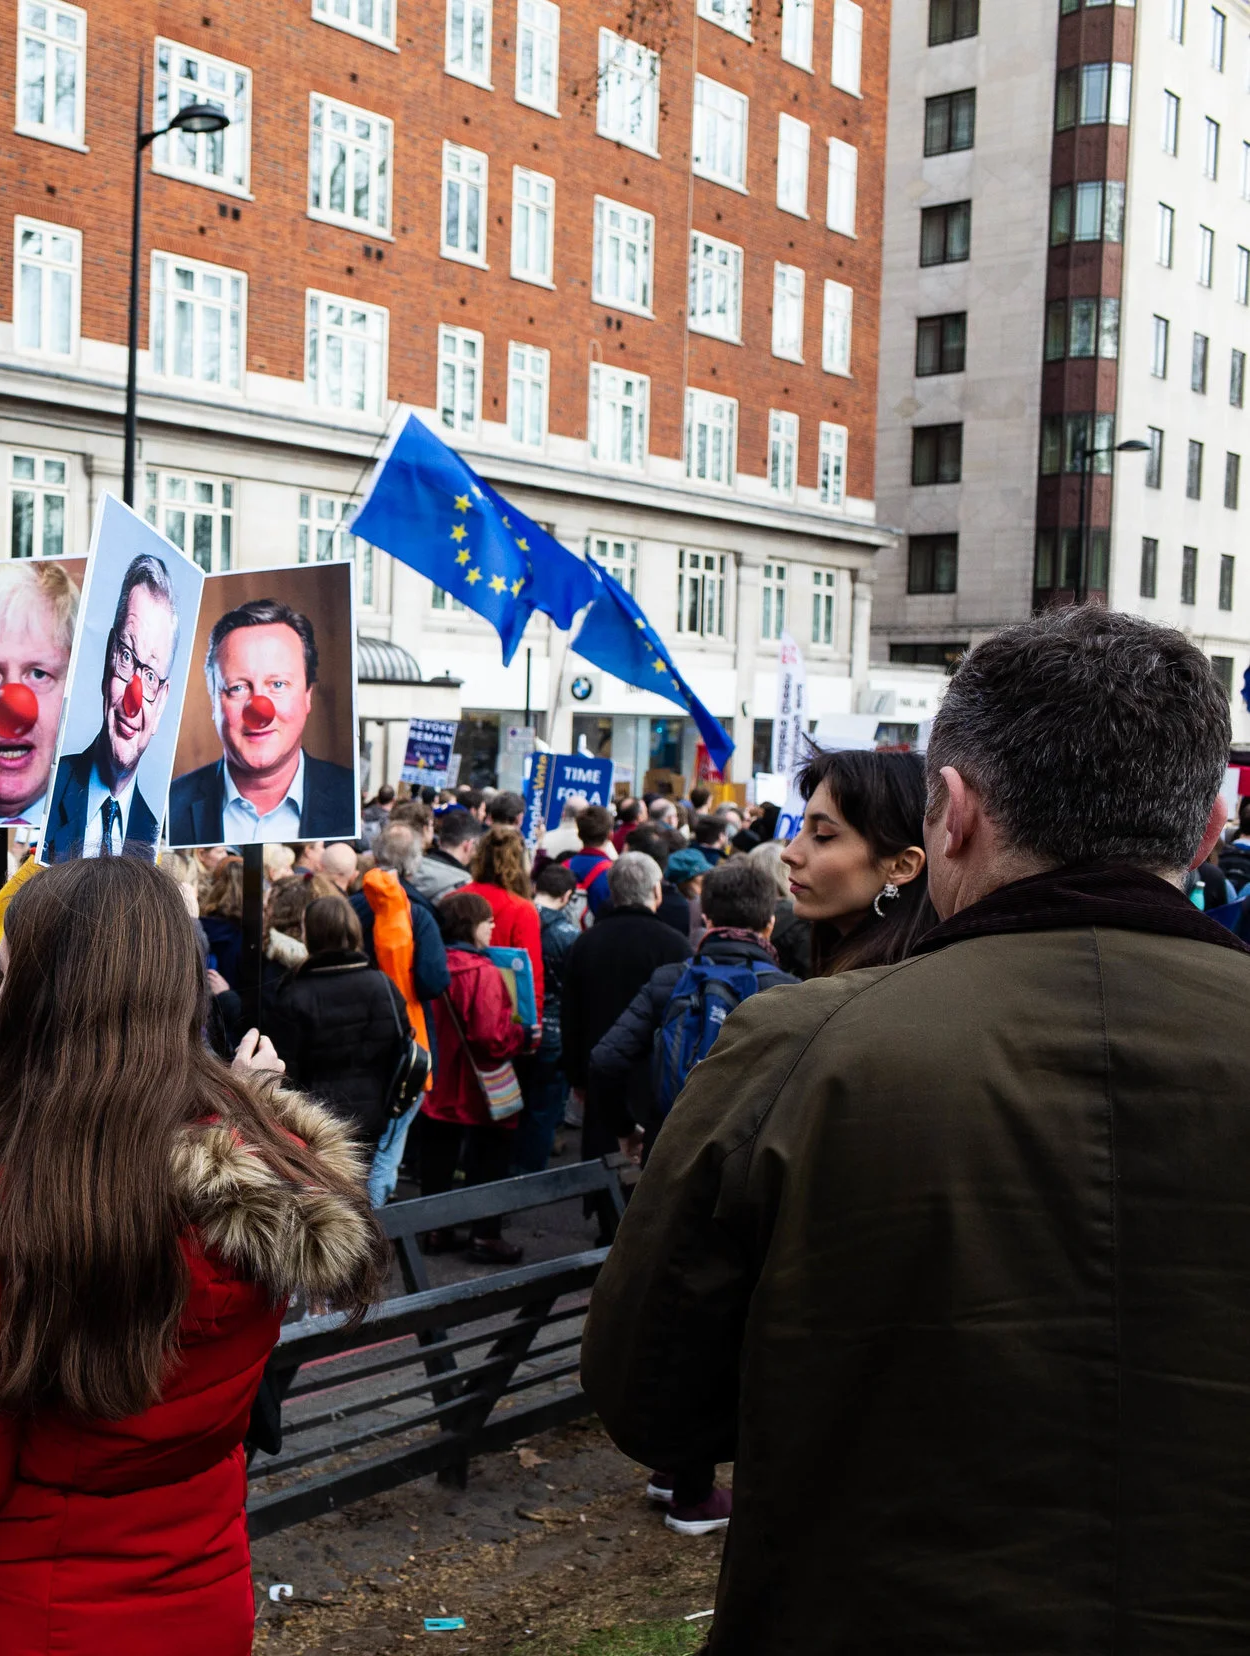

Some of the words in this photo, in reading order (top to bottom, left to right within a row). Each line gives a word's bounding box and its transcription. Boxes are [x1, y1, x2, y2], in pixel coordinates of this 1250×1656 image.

[408, 729, 453, 746] REMAIN
[563, 766, 602, 785] TIME
[556, 786, 588, 801] FOR
[589, 790, 602, 806] A
